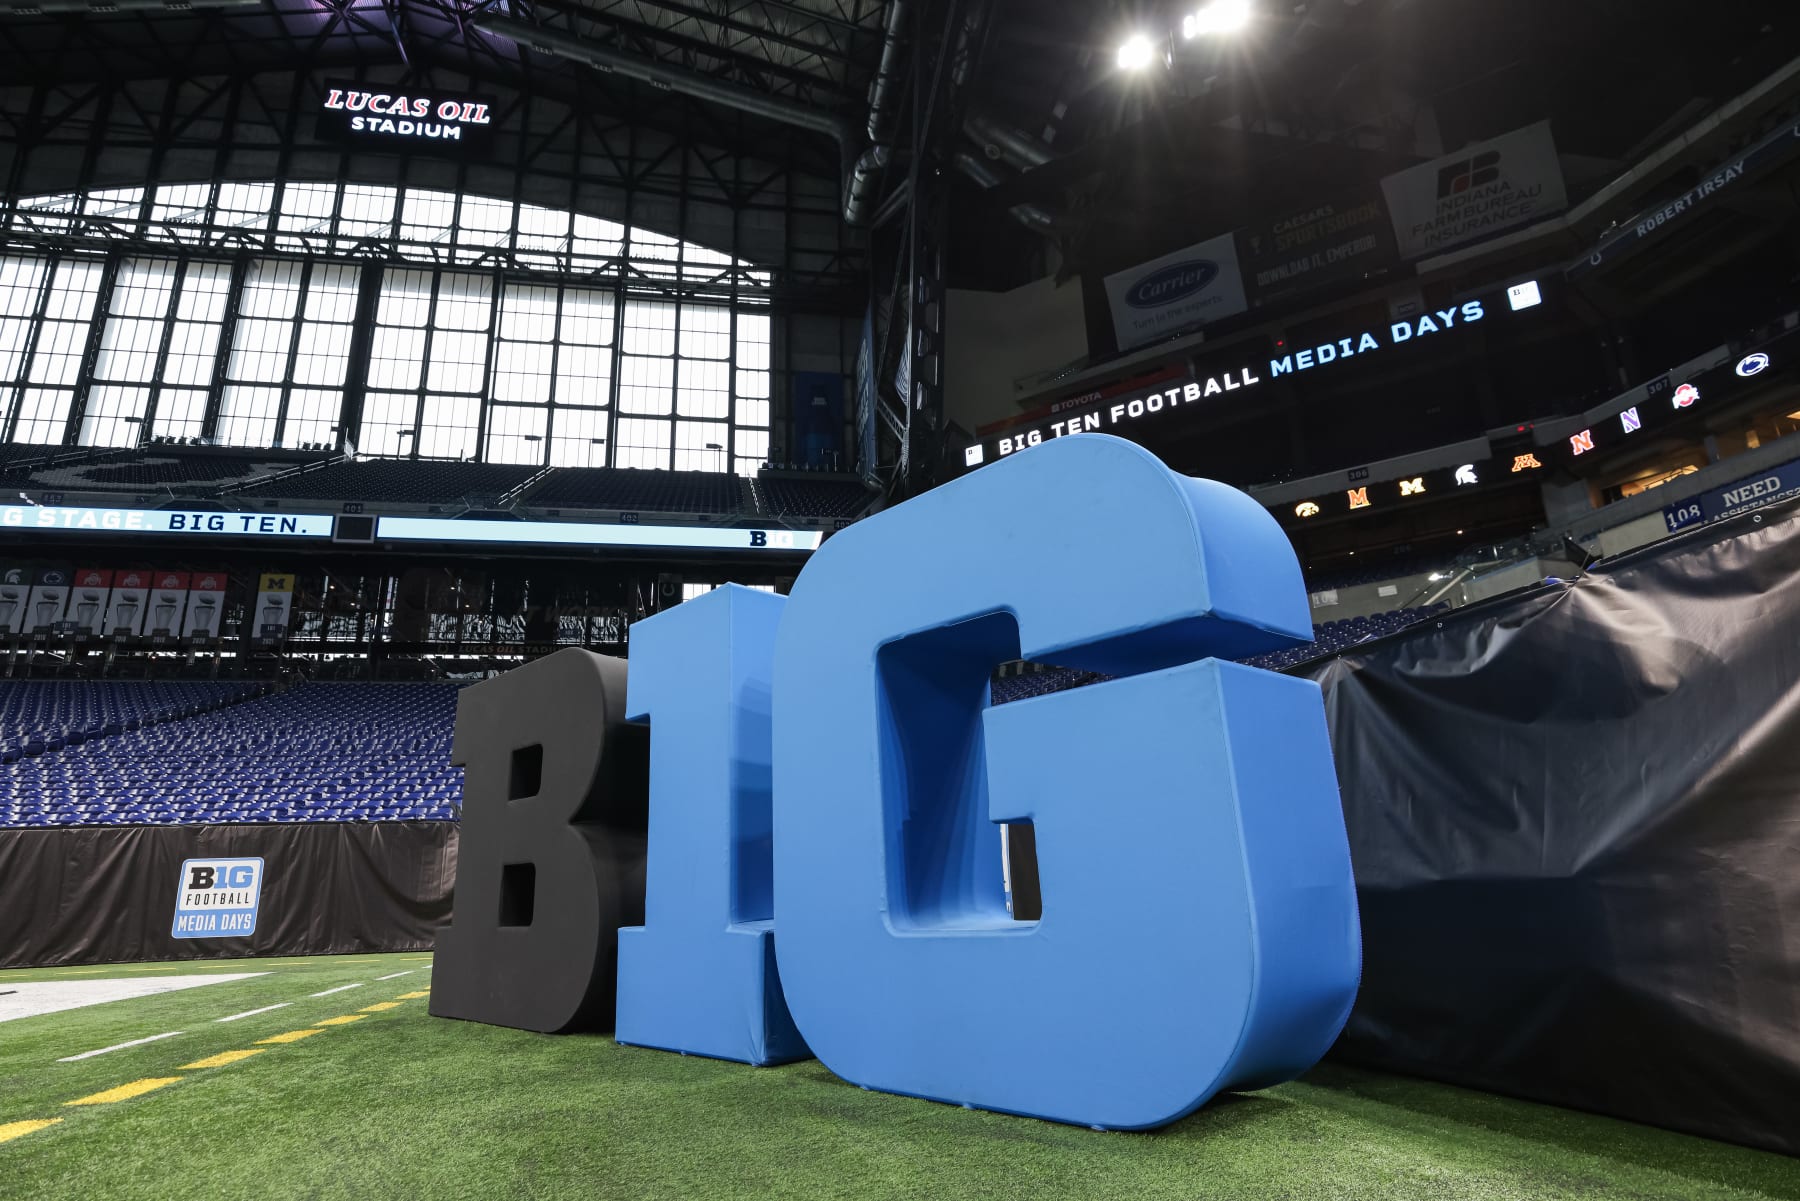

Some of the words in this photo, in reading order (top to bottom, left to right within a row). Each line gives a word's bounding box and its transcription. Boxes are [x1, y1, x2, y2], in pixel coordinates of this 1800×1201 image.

[324, 88, 430, 117] LUCAS
[437, 101, 491, 124] OIL
[351, 116, 461, 140] STADIUM
[1436, 180, 1512, 215] INDIANA
[1636, 193, 1693, 238] ROBERT
[1696, 160, 1745, 200] IRSAY
[1273, 204, 1335, 233] CAESARS
[1424, 203, 1532, 248] INSURANCE
[1138, 267, 1206, 300] Carrier
[1256, 257, 1310, 287] DOWNLOAD
[999, 429, 1042, 457] BIG
[1050, 411, 1101, 438] TEN
[1109, 367, 1260, 423] FOOTBALL
[1269, 332, 1380, 378] MEDIA
[1390, 300, 1486, 344] DAYS
[1650, 379, 1668, 394] 307
[1060, 391, 1103, 409] TOYOTA
[1349, 469, 1368, 480] 306
[1722, 476, 1781, 508] NEED
[37, 509, 153, 529] STAGE.
[168, 513, 225, 531] BIG
[240, 515, 307, 534] TEN.
[1667, 504, 1701, 529] 108
[185, 892, 249, 906] FOOTBALL
[177, 914, 216, 932] MEDIA
[221, 913, 252, 931] DAYS
